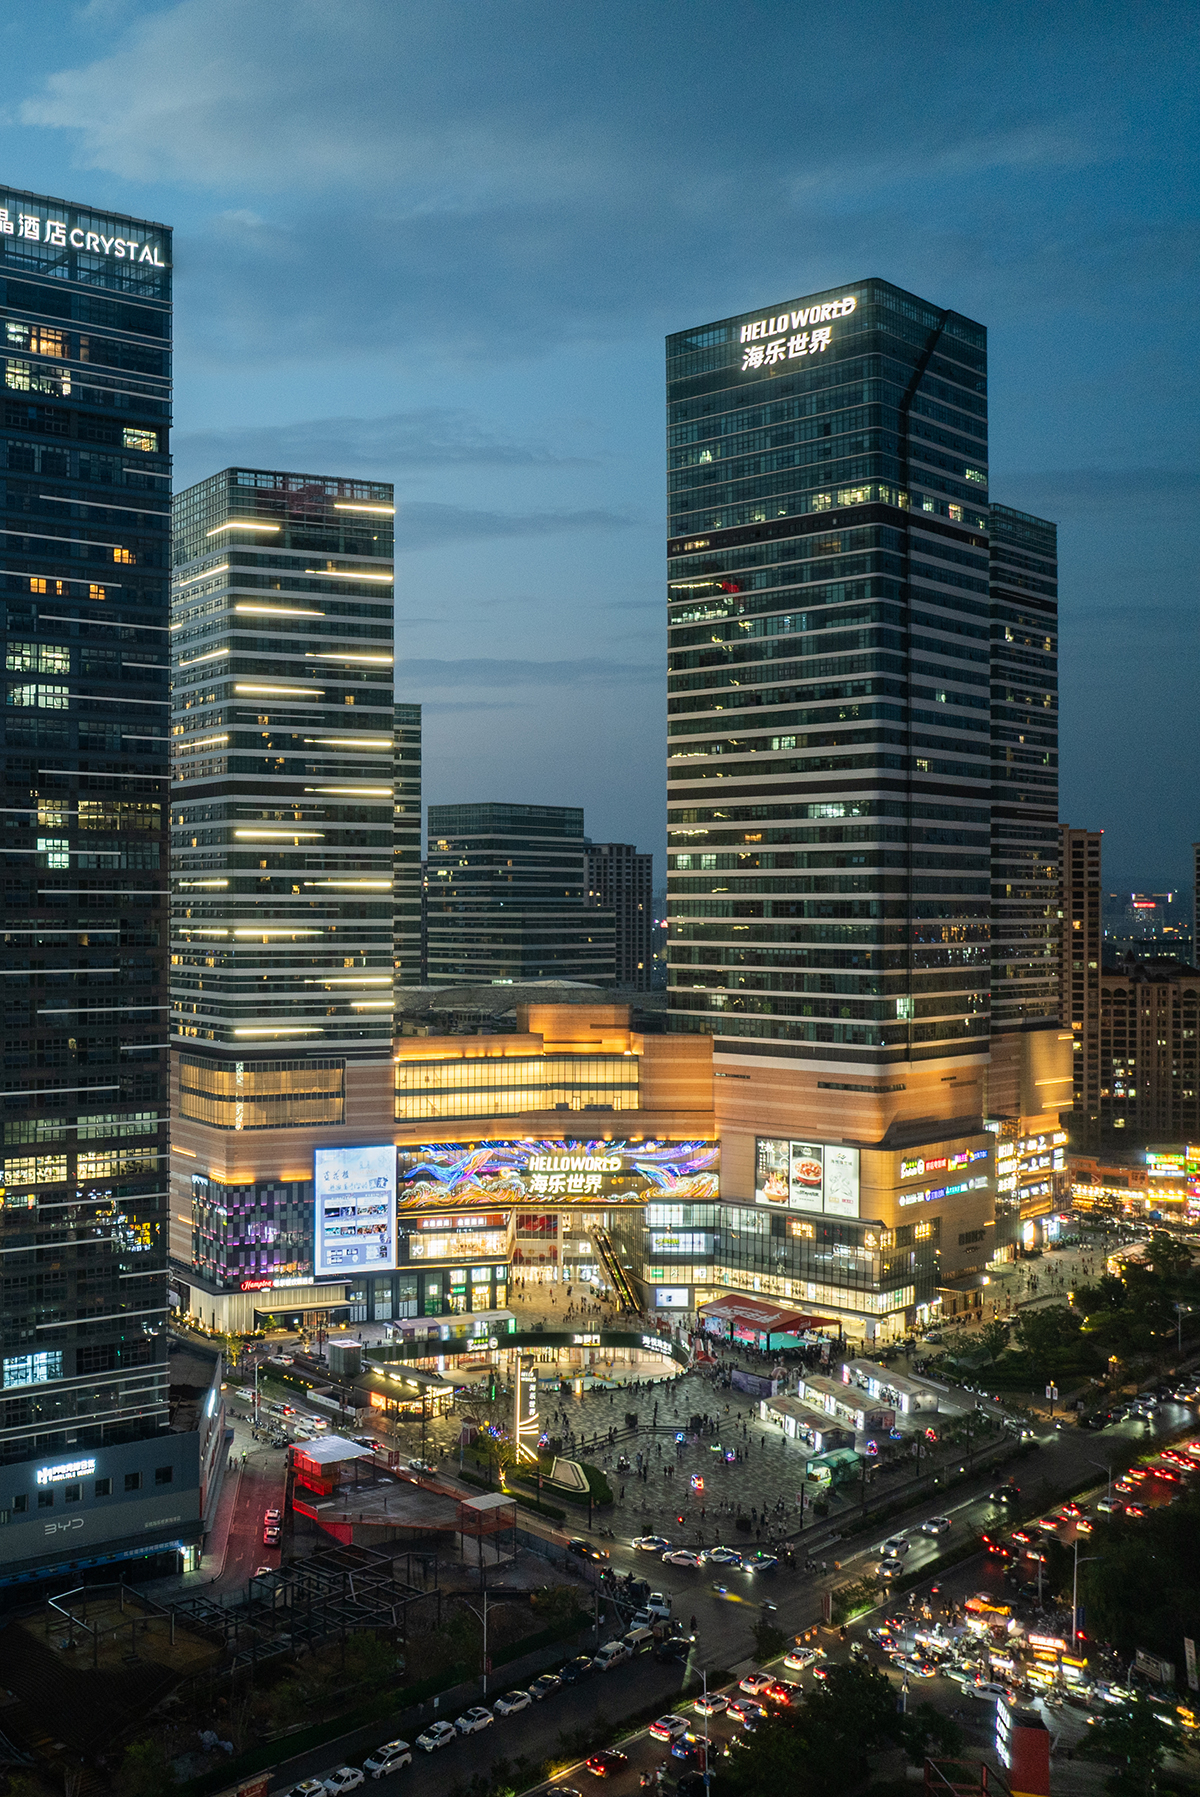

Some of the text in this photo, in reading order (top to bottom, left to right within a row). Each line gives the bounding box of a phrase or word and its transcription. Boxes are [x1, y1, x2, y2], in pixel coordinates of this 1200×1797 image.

[70, 228, 165, 268] CRYSTAL
[740, 296, 857, 344] HELLO WORLD
[741, 326, 833, 372] 海乐世界
[528, 1173, 603, 1195] 海乐世界
[241, 1279, 273, 1291] Hampton
